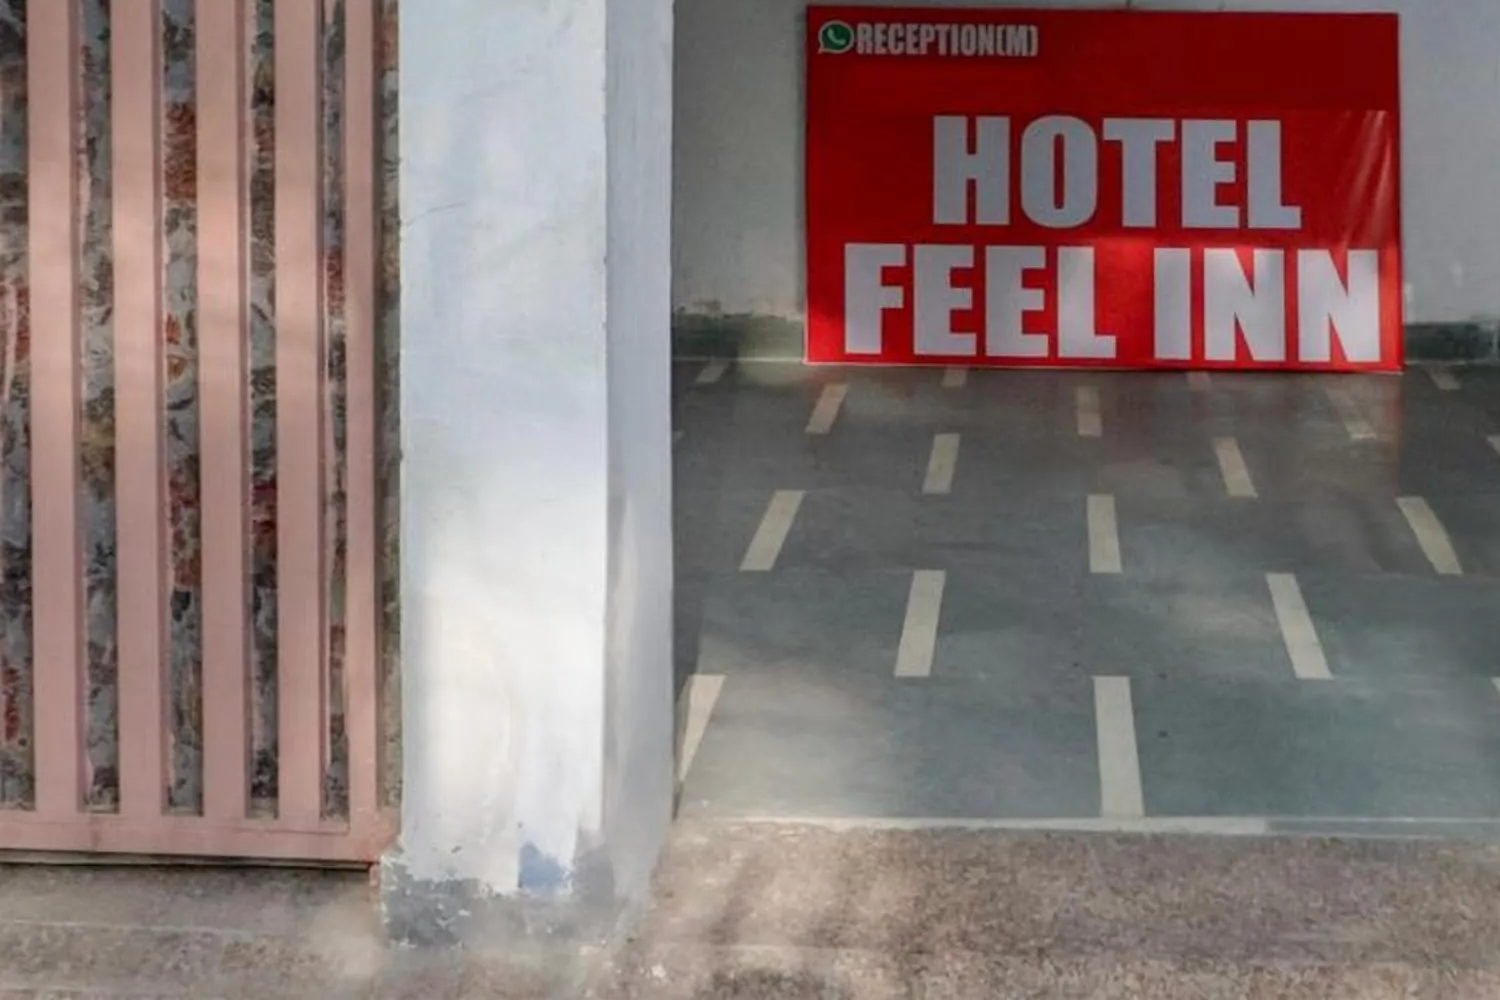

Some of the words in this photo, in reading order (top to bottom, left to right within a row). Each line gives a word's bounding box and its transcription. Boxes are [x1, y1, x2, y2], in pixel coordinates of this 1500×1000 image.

[933, 115, 1302, 229] HOTEL
[845, 243, 1117, 359] FEEL
[1154, 247, 1381, 362] INN
